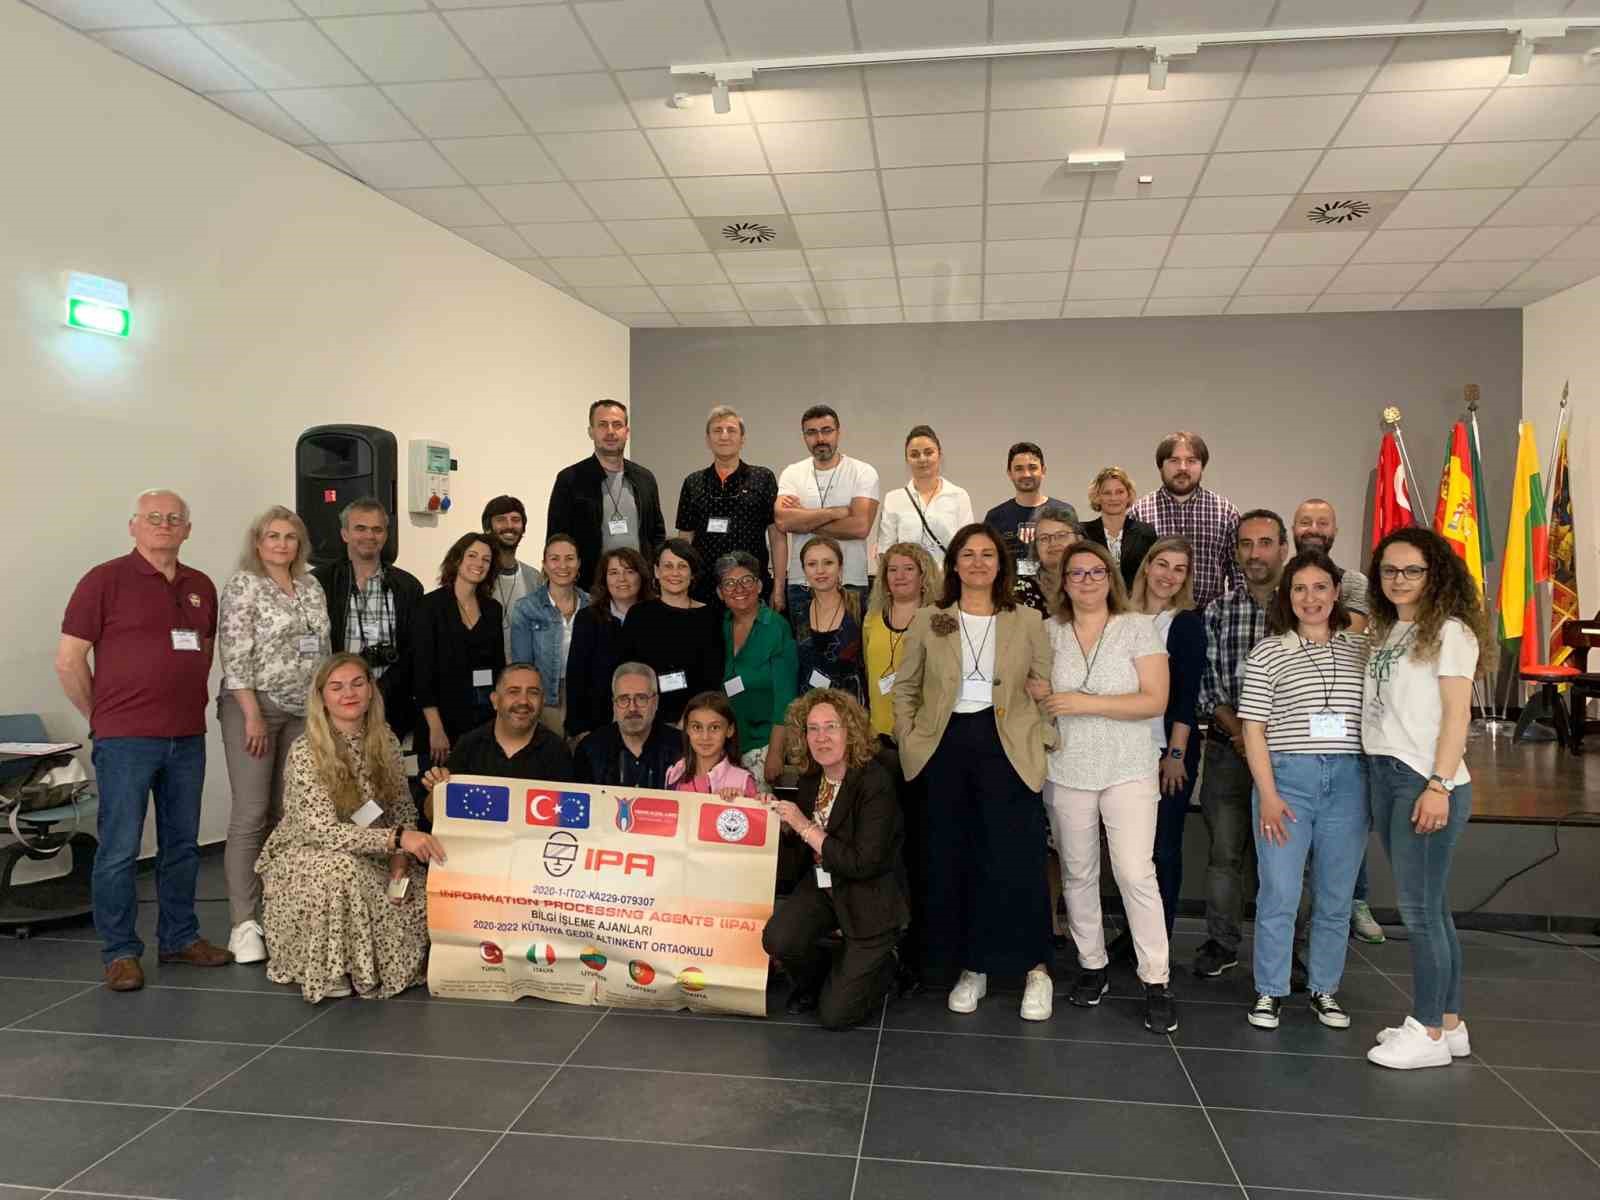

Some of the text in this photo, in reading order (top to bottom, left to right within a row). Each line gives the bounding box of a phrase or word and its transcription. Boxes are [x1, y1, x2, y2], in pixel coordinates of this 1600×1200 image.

[584, 848, 655, 877] IPA
[440, 889, 758, 932] INFORMATION PROCESSING AGENTS (IPA)
[533, 885, 656, 907] 2020-1-IT02-KA229-079307
[473, 919, 518, 932] 2020-2022
[596, 935, 648, 952] ALTINKENT
[651, 942, 714, 958] ORTAOKULU
[598, 921, 653, 937] AJANLARI
